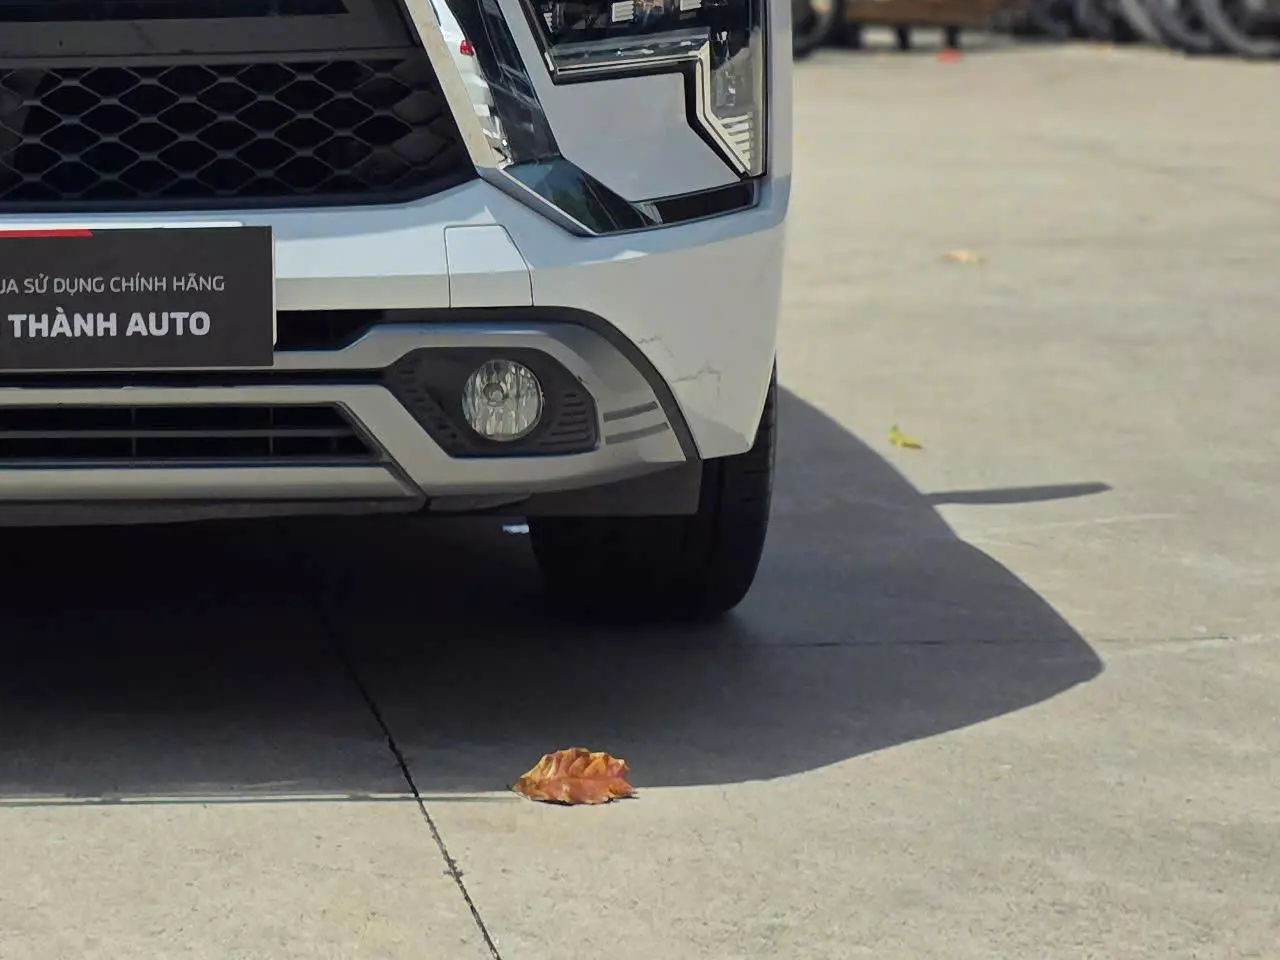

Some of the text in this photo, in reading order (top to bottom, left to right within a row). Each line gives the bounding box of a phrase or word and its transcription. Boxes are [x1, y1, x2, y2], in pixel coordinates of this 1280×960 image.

[23, 272, 49, 294] SỬ
[53, 276, 105, 296] DỤNG
[109, 272, 167, 293] CHÍNH
[172, 272, 225, 292] HÃNG
[7, 306, 118, 338] THÀNH
[125, 311, 211, 337] AUTO
